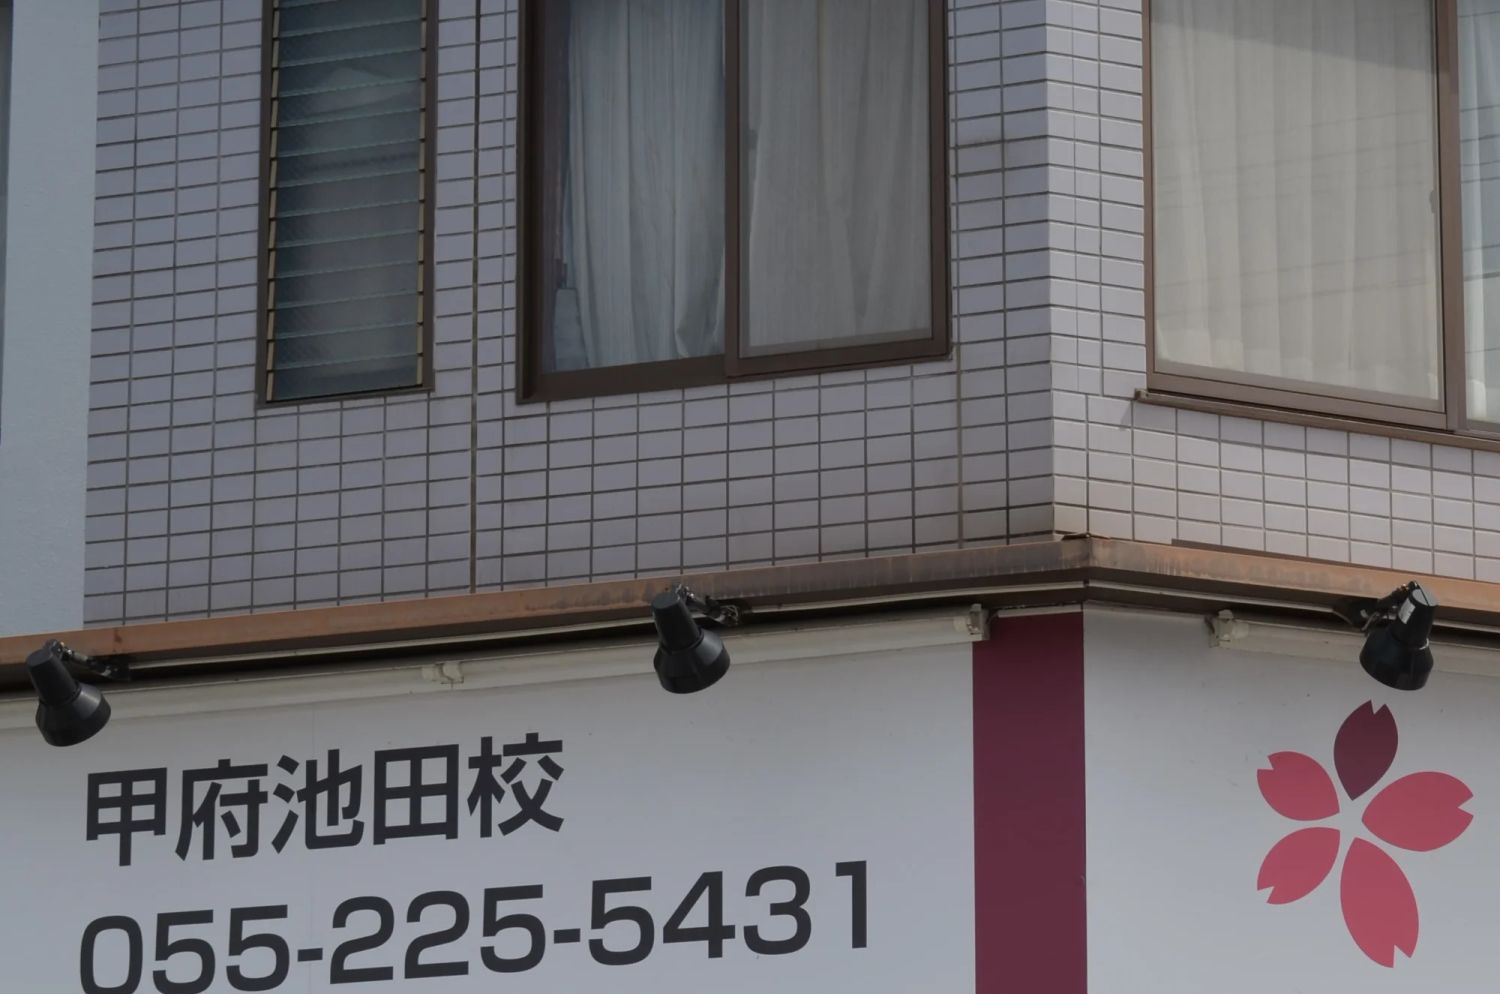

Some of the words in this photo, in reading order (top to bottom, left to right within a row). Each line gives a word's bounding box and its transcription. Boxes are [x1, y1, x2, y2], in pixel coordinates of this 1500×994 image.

[84, 732, 565, 867] 甲府池田校
